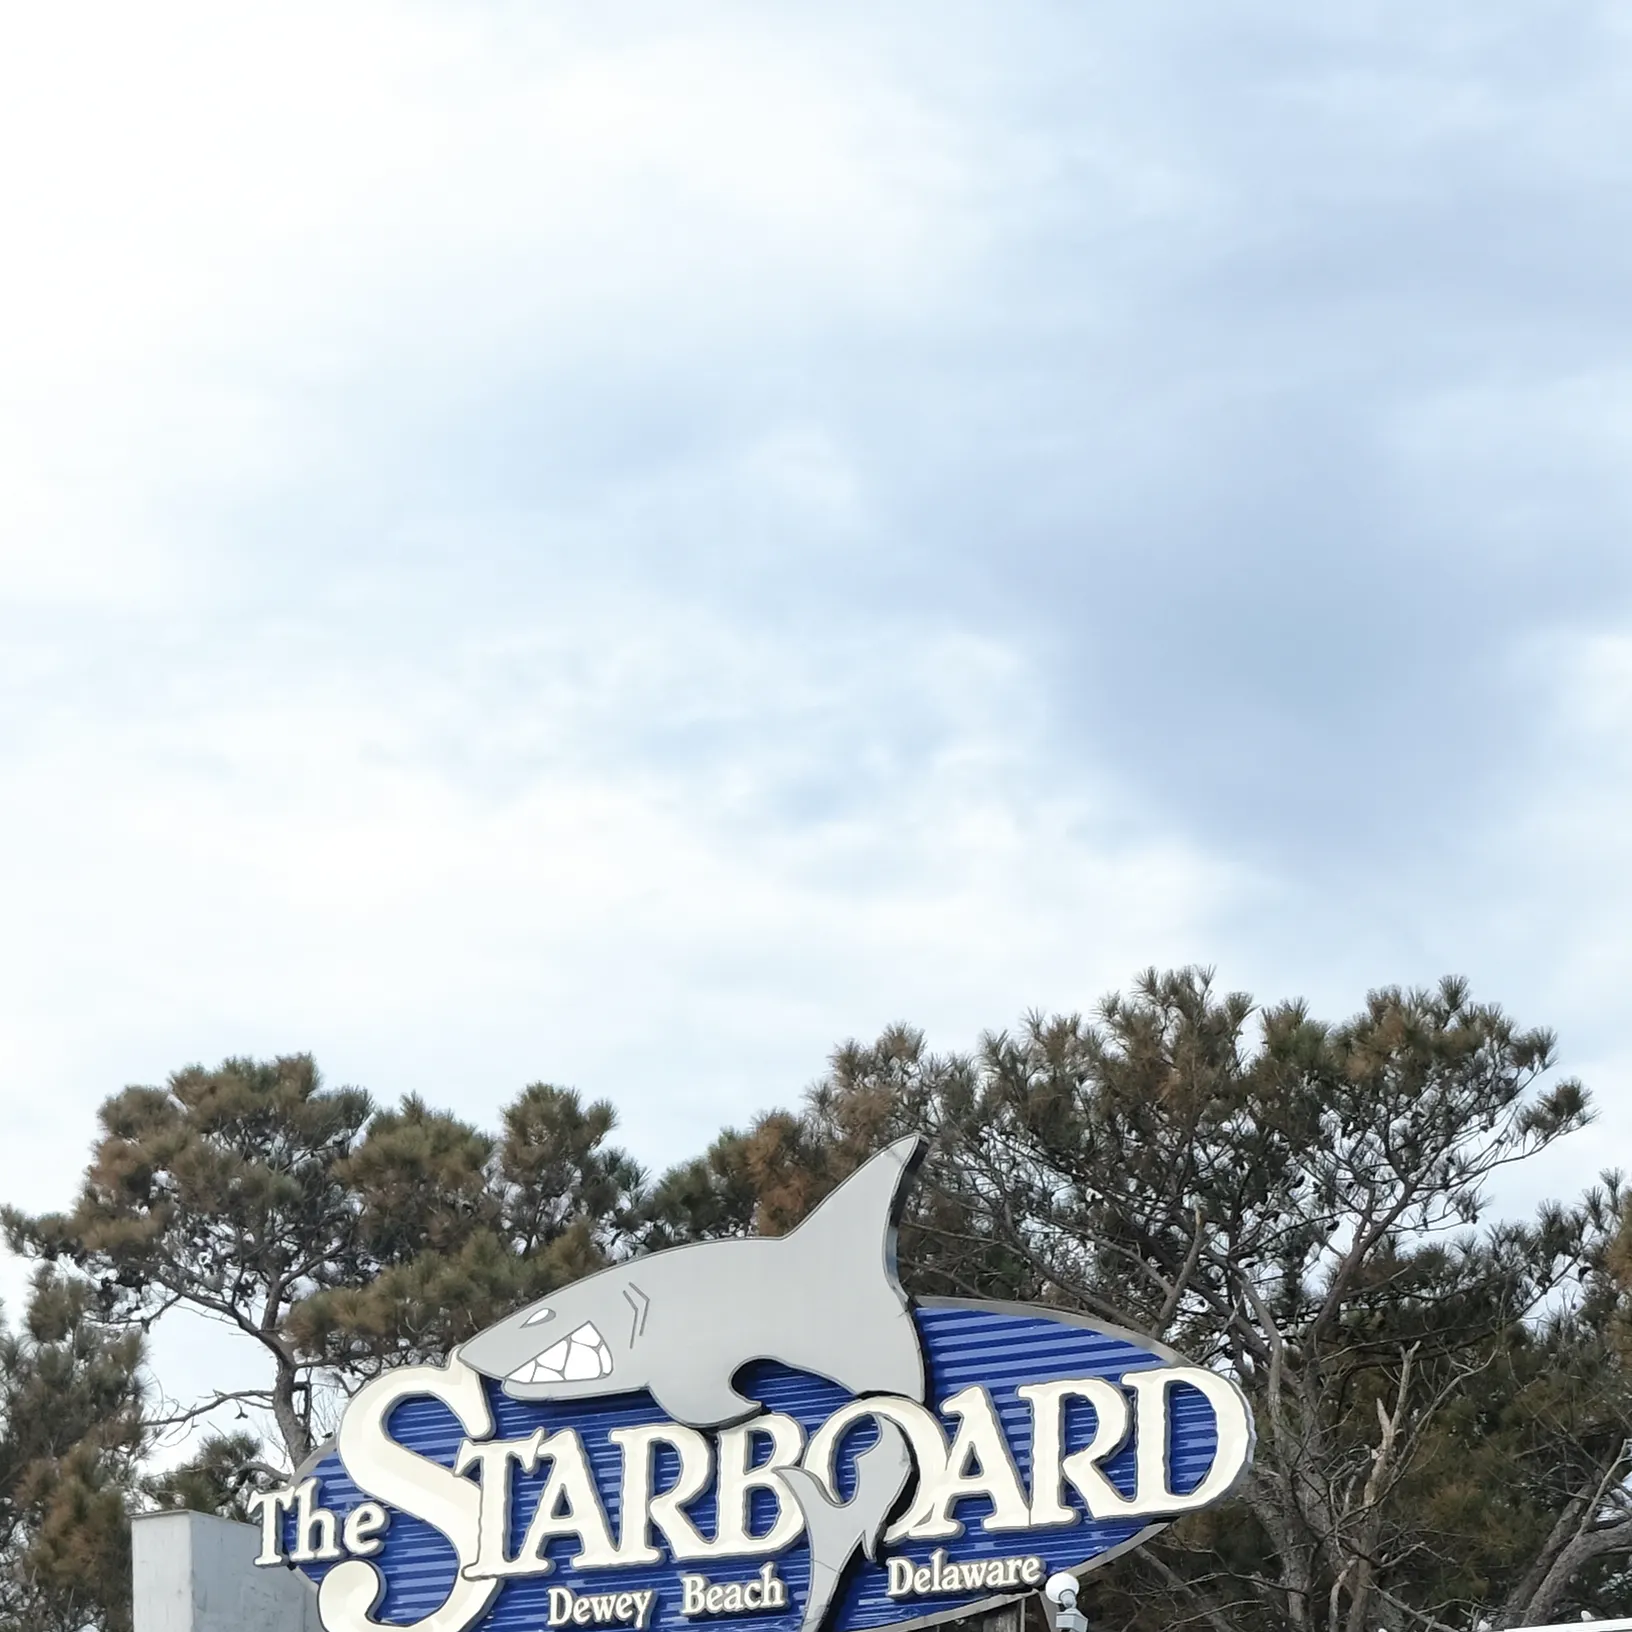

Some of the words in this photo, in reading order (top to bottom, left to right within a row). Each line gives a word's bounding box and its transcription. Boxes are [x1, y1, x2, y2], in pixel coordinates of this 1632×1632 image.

[247, 1475, 386, 1568] The
[547, 1586, 653, 1629] Dewey
[681, 1562, 785, 1617] Beach
[886, 1549, 1043, 1597] Delaware
